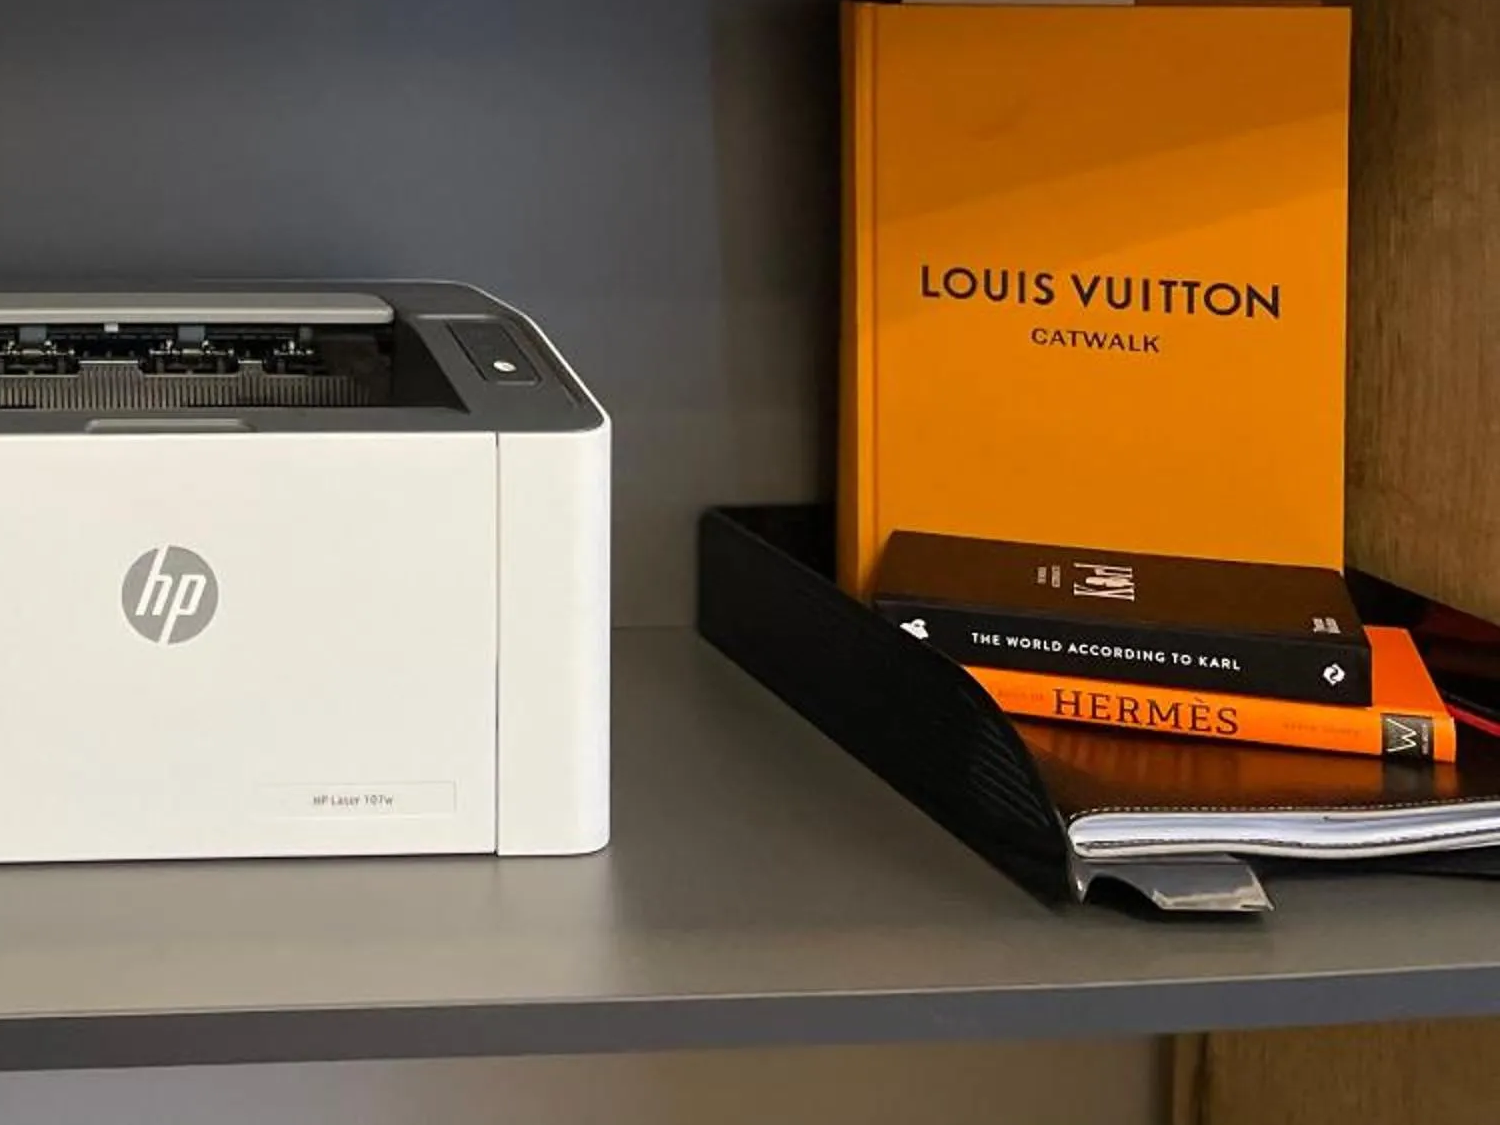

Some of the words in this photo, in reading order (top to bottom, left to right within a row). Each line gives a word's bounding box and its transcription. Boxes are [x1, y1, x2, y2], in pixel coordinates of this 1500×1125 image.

[920, 265, 1057, 308] LOUIS
[1076, 274, 1282, 320] VUITTON
[1030, 327, 1161, 356] CATWALK
[134, 544, 207, 645] hp
[971, 632, 1001, 646] THE
[1005, 635, 1063, 653] WORLD
[1067, 642, 1166, 664] ACCORDING
[1171, 652, 1193, 666] TO
[1199, 655, 1242, 671] KARL
[1051, 687, 1240, 737] HERMÈS
[1386, 718, 1418, 753] W
[313, 795, 328, 806] HP
[331, 795, 360, 806] Laser
[364, 795, 393, 806] 107w
